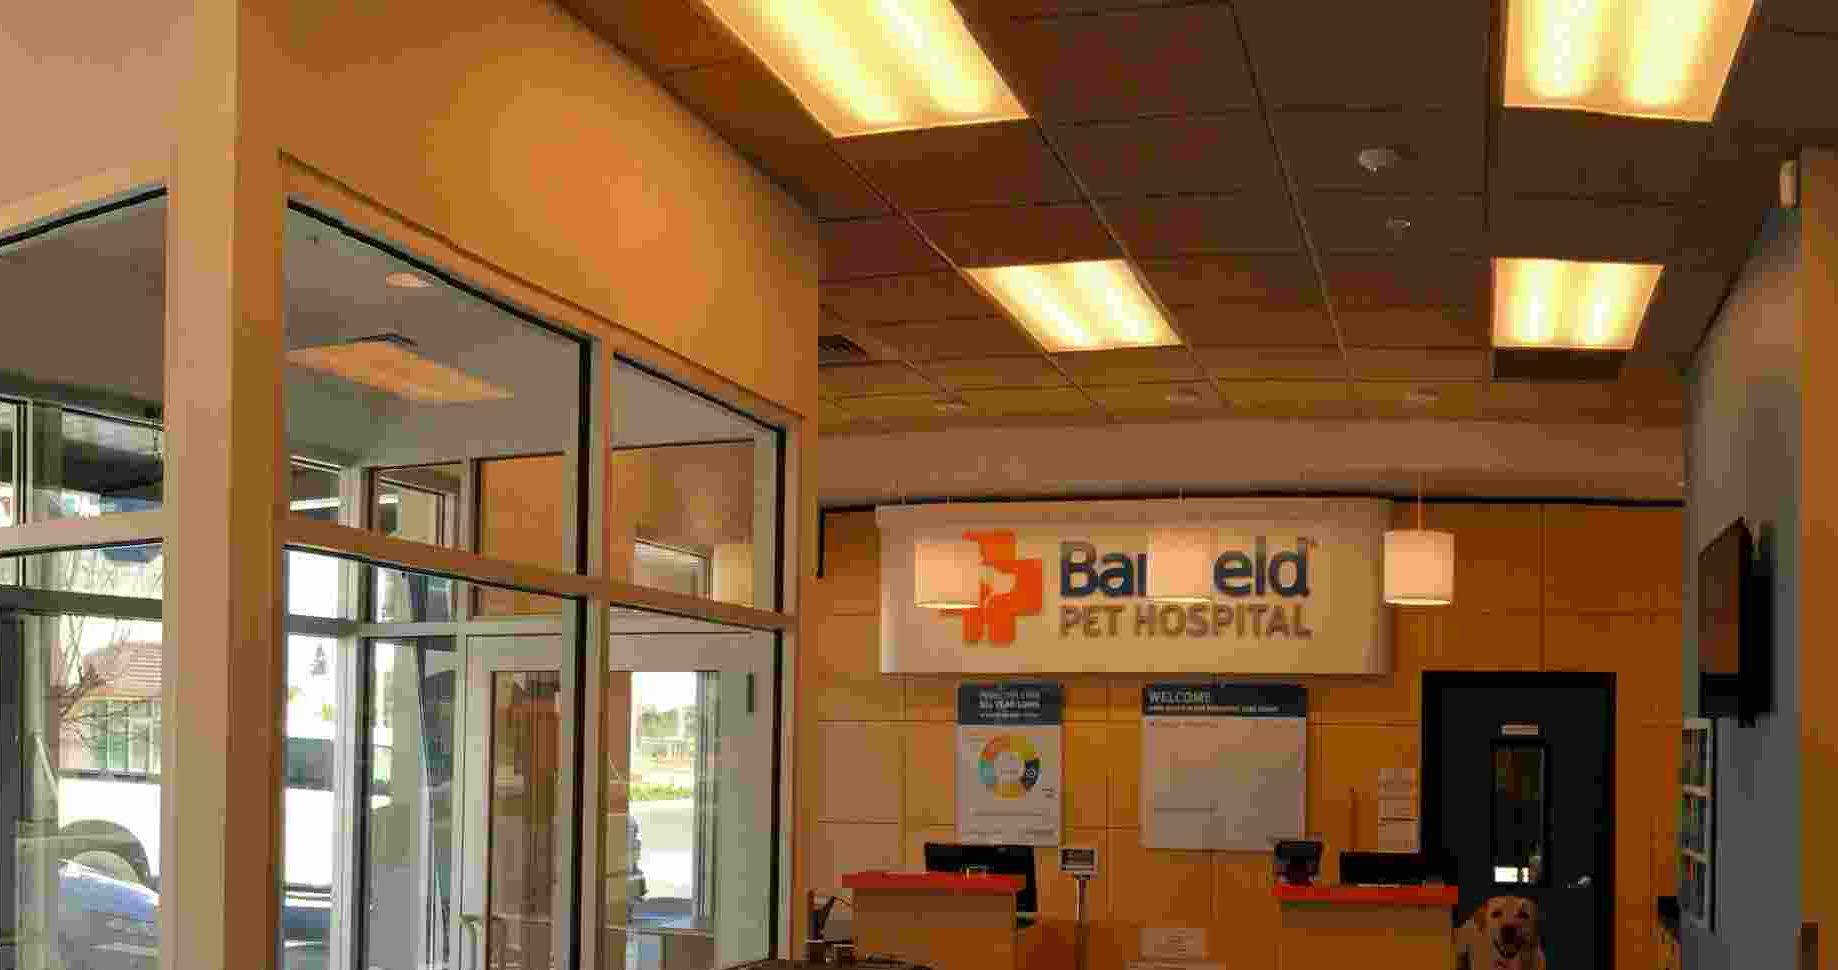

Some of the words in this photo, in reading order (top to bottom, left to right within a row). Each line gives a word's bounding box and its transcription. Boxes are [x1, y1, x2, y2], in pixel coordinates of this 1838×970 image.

[1060, 603, 1124, 639] PET
[1135, 603, 1313, 639] HOSPITAL
[1147, 690, 1212, 706] WELCOME
